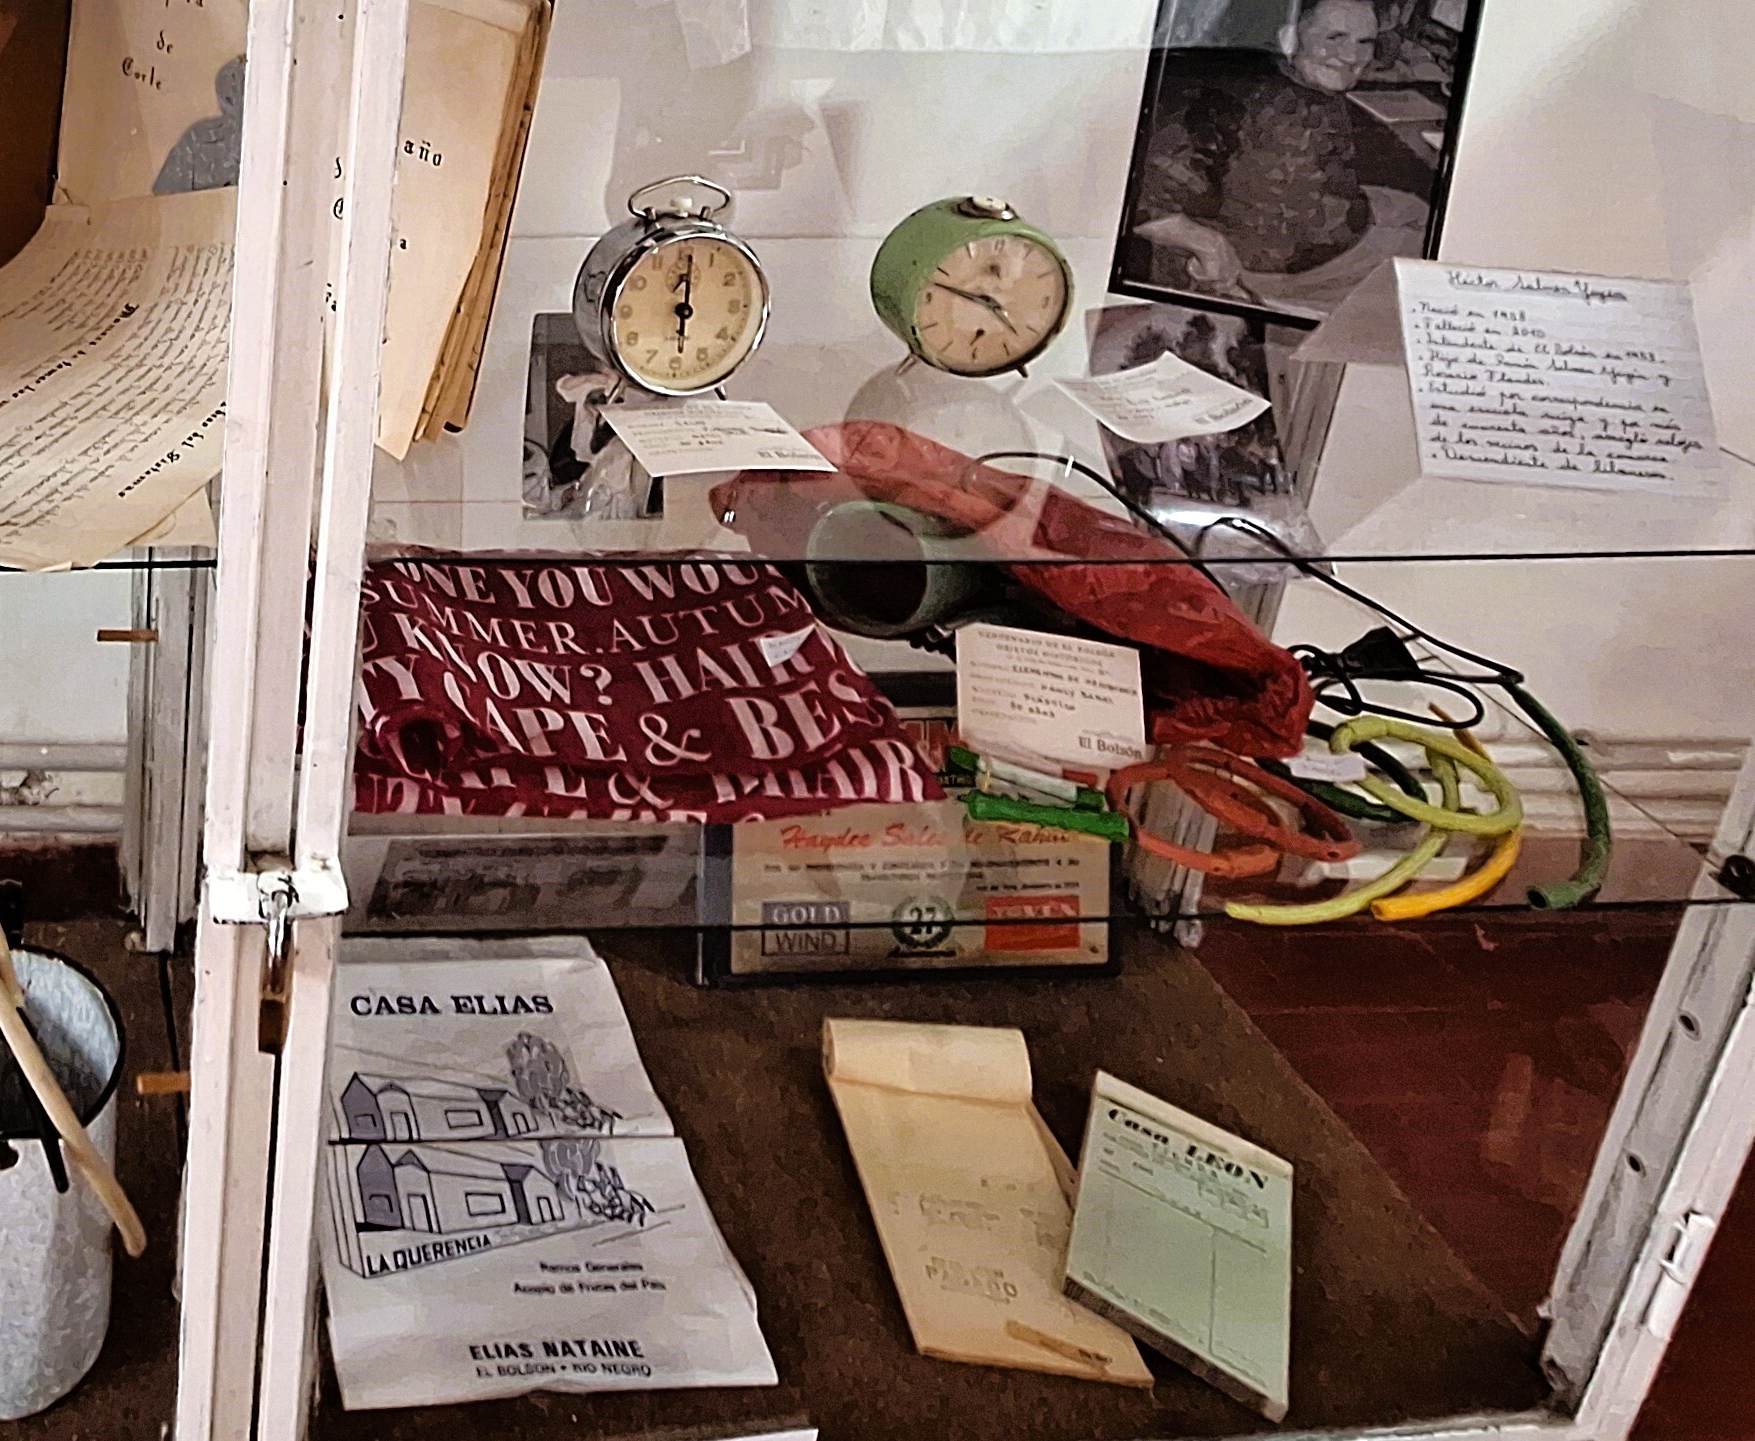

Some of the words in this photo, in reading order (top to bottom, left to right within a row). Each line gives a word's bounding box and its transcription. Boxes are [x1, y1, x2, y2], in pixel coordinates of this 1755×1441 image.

[499, 566, 614, 609] YOU
[618, 560, 785, 601] WOU
[639, 713, 712, 767] &
[1078, 736, 1092, 749] El
[1097, 739, 1143, 759] Bolsón
[773, 905, 842, 924] GOLD
[909, 907, 938, 935] 27
[774, 931, 837, 951] WIND
[350, 996, 440, 1017] CASA
[451, 995, 554, 1016] ELIAS
[1108, 1108, 1169, 1145] Casa
[1186, 1144, 1269, 1190] LEON
[365, 1252, 390, 1276] LA
[394, 1233, 492, 1271] QUERENCIA
[469, 1344, 534, 1361] ELIAS
[543, 1340, 645, 1359] NATAINE
[476, 1364, 494, 1378] EL
[497, 1363, 557, 1377] BOLSON
[572, 1362, 597, 1376] RIO
[602, 1362, 652, 1377] NEGRO
